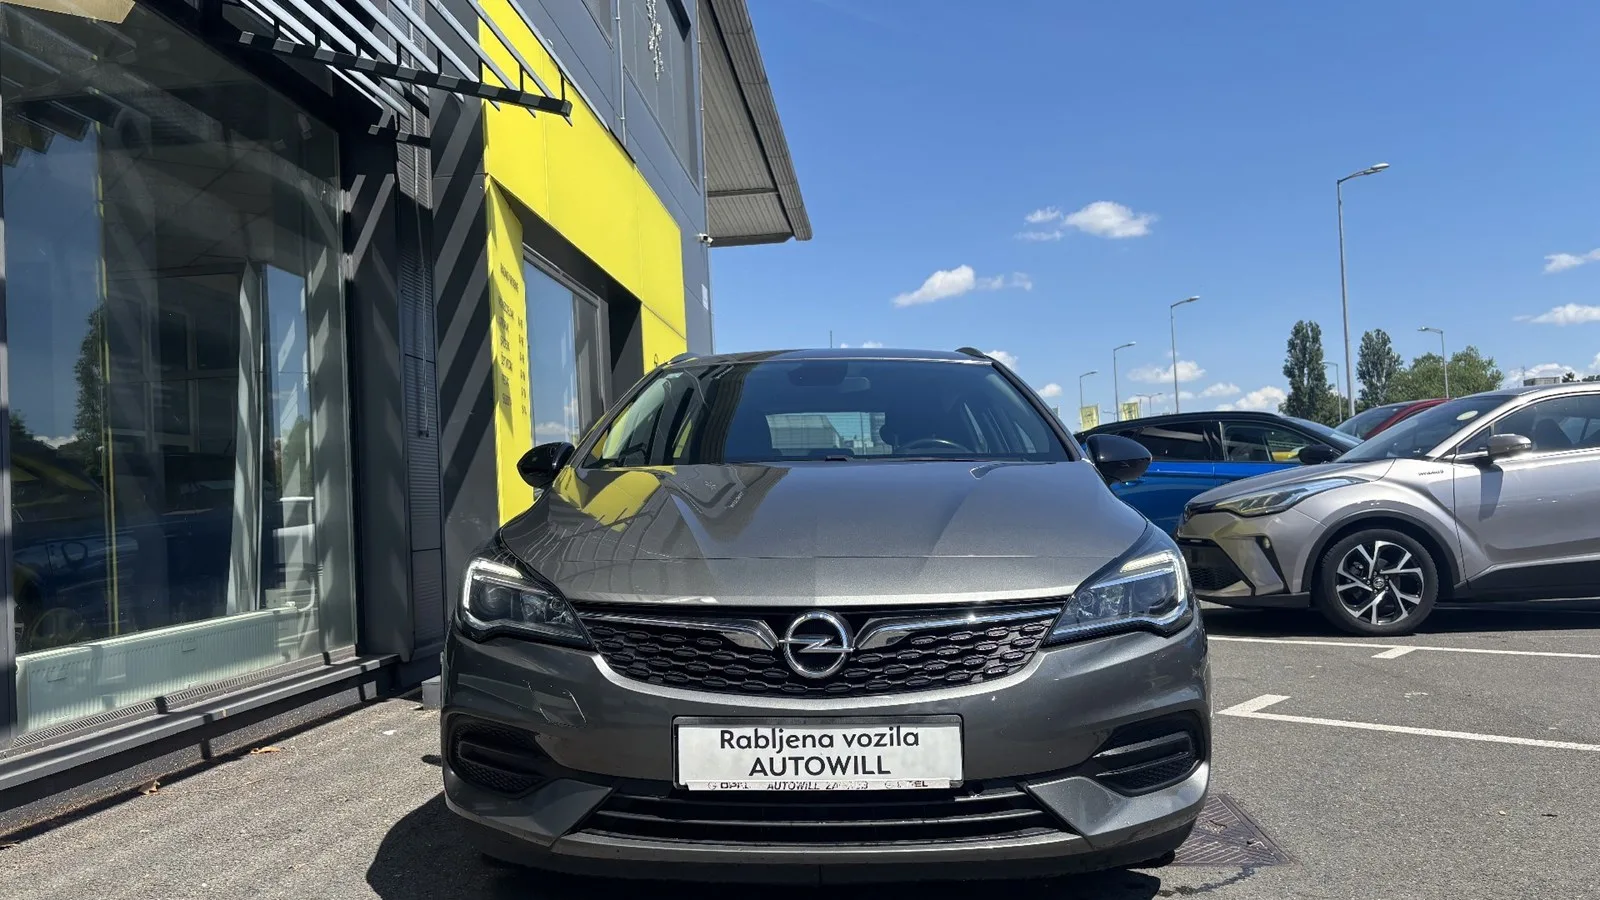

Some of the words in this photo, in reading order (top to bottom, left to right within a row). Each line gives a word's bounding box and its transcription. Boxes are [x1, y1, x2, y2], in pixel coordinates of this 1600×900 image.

[720, 728, 834, 754] Rabljena
[842, 726, 919, 748] vozila
[749, 755, 891, 777] AUTOWILL
[766, 781, 820, 790] AUTOWILL
